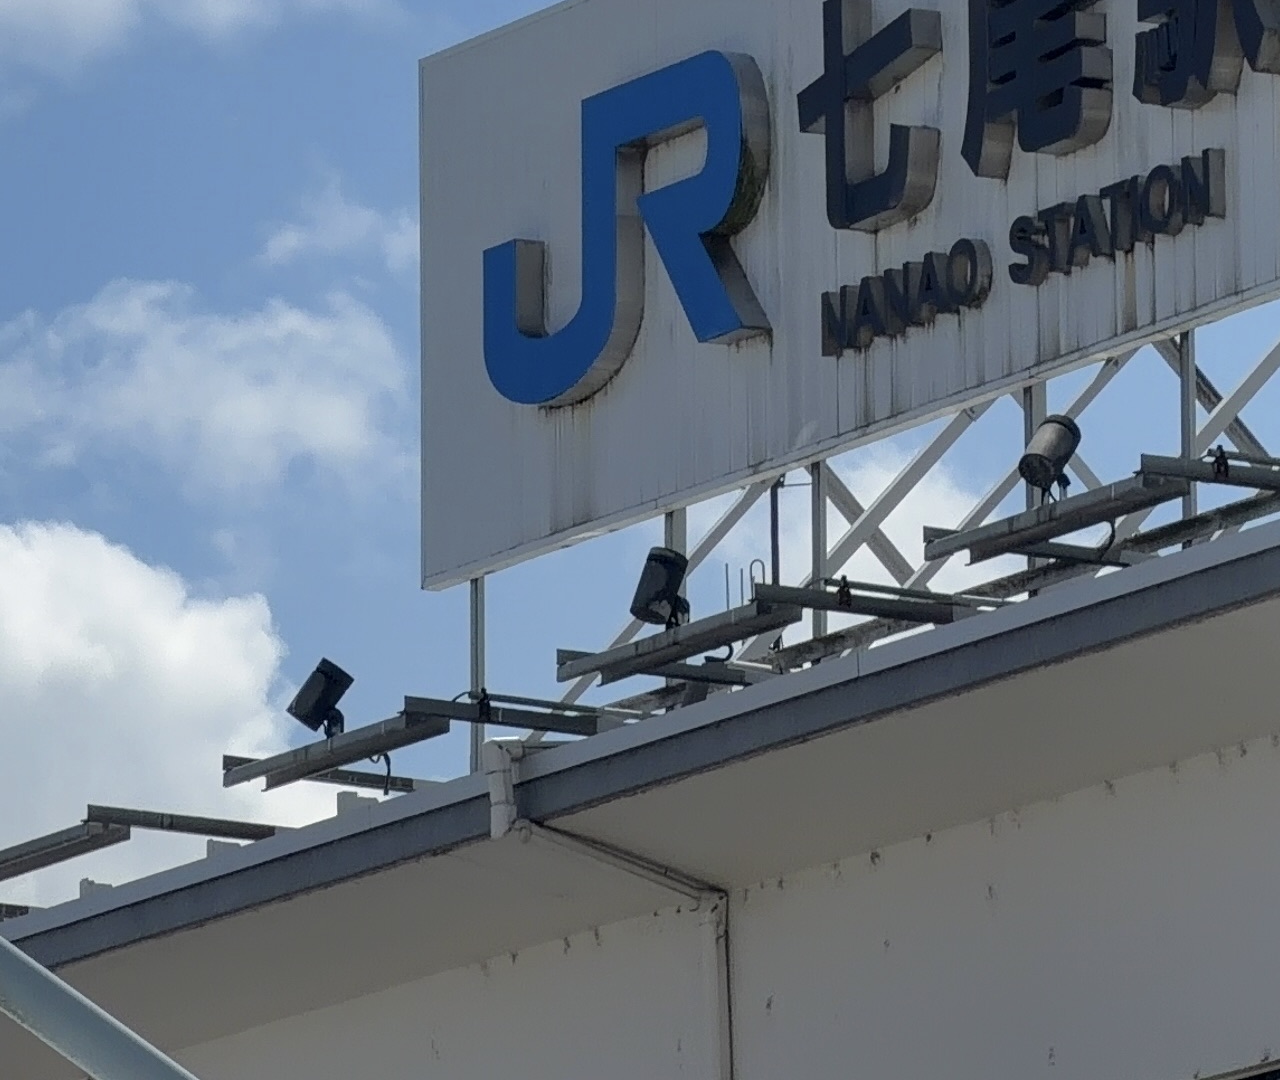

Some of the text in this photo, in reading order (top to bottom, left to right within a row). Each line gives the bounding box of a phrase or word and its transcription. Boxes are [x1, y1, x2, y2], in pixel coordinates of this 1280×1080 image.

[483, 49, 768, 407] JR
[821, 148, 1226, 357] NANAO STATION
